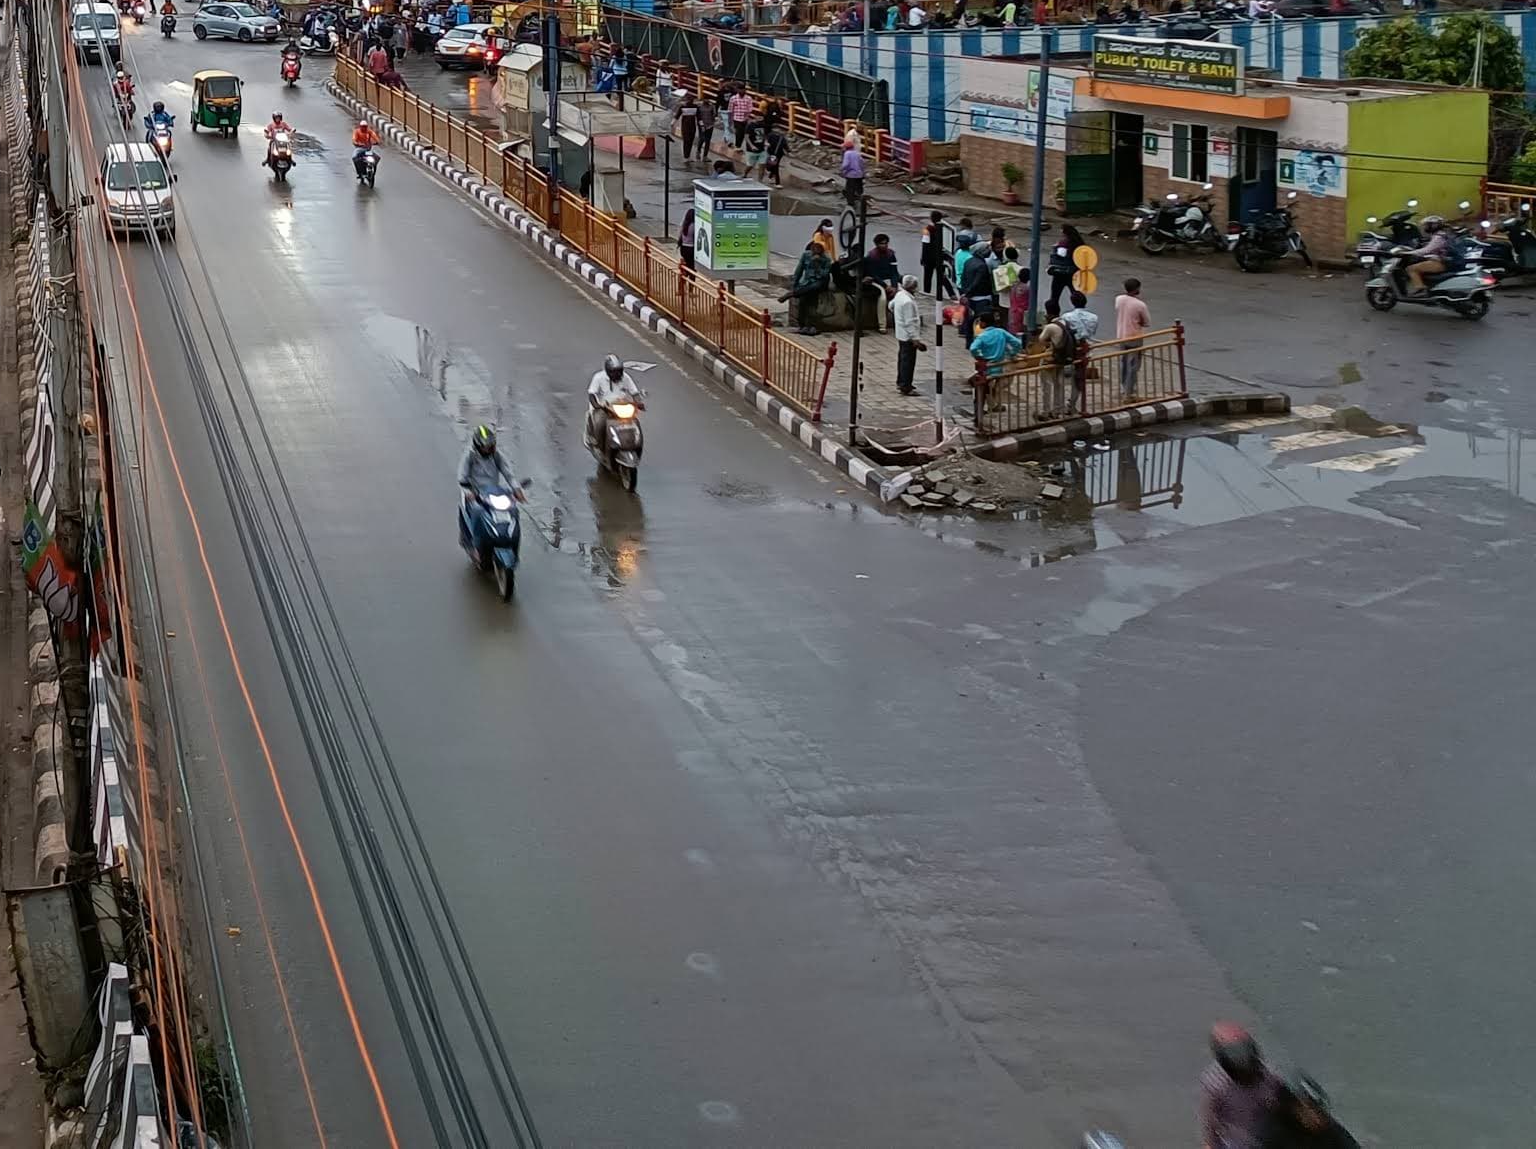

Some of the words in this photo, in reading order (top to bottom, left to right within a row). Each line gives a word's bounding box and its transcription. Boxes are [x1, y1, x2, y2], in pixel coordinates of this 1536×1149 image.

[1095, 53, 1139, 67] PUBLIC
[1143, 57, 1185, 72] TOILET
[1188, 63, 1197, 73] &
[1200, 64, 1235, 78] BATH
